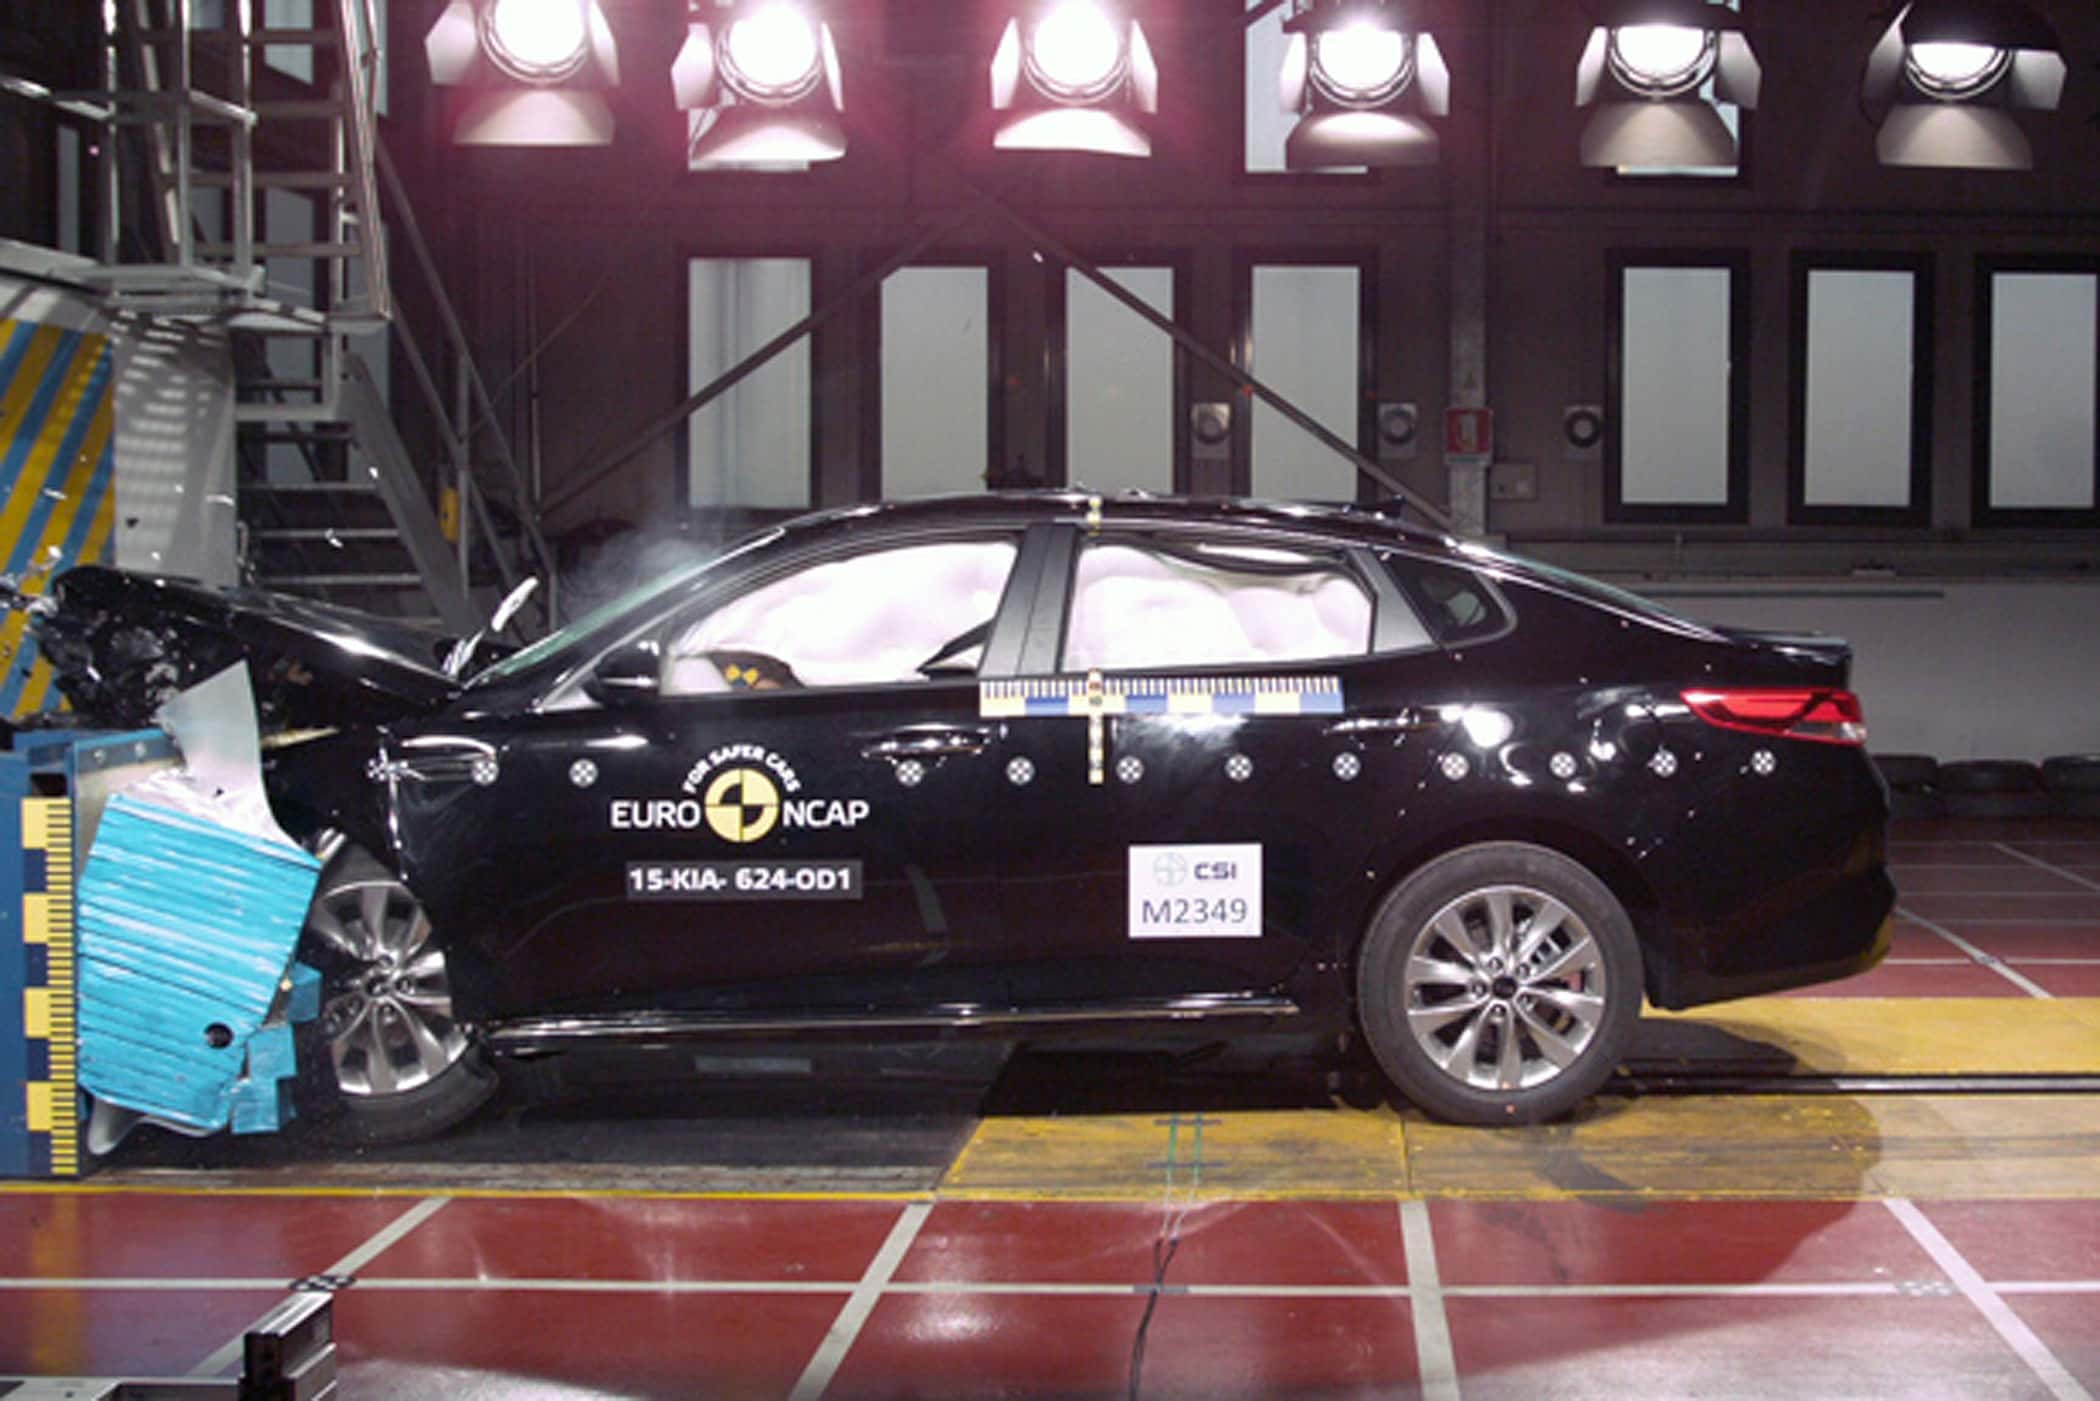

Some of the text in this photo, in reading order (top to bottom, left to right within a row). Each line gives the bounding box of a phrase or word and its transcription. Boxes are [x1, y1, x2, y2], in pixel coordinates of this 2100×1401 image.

[682, 744, 801, 794] FOR SAFER CARS
[611, 800, 870, 828] EURO NCAP
[629, 867, 727, 891] 15-KIA-
[1194, 861, 1237, 880] CSI
[1141, 898, 1248, 924] M2349
